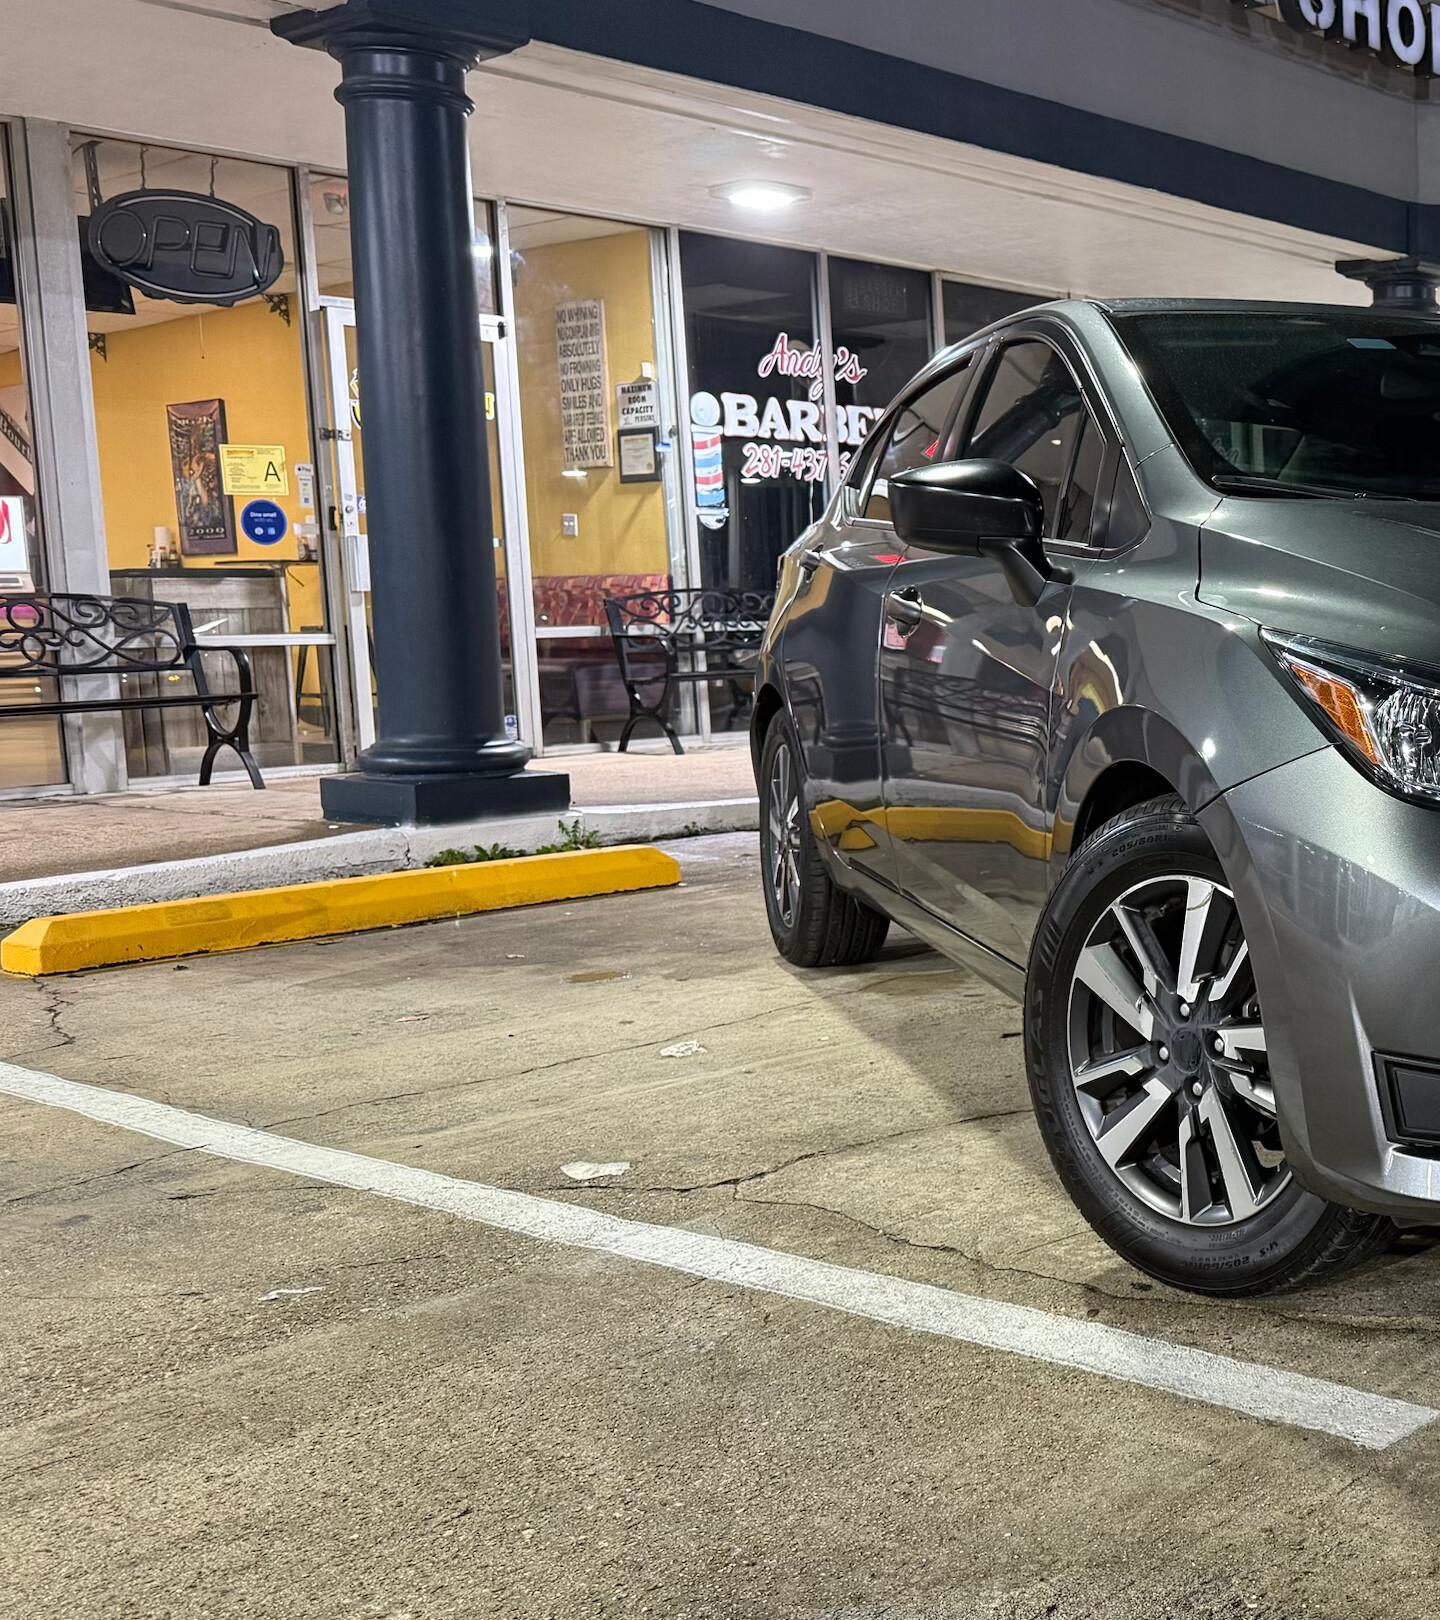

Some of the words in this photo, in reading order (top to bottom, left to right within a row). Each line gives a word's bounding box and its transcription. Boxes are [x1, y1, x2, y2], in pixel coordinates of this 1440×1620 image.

[97, 209, 275, 282] OPEN
[561, 379, 580, 394] ONLY
[581, 375, 602, 392] HUGS
[622, 405, 653, 416] CAPACITY
[720, 391, 886, 446] BARBE
[565, 446, 589, 463] THANK
[590, 444, 606, 460] YOU
[264, 460, 282, 483] A
[188, 526, 225, 536] 2000
